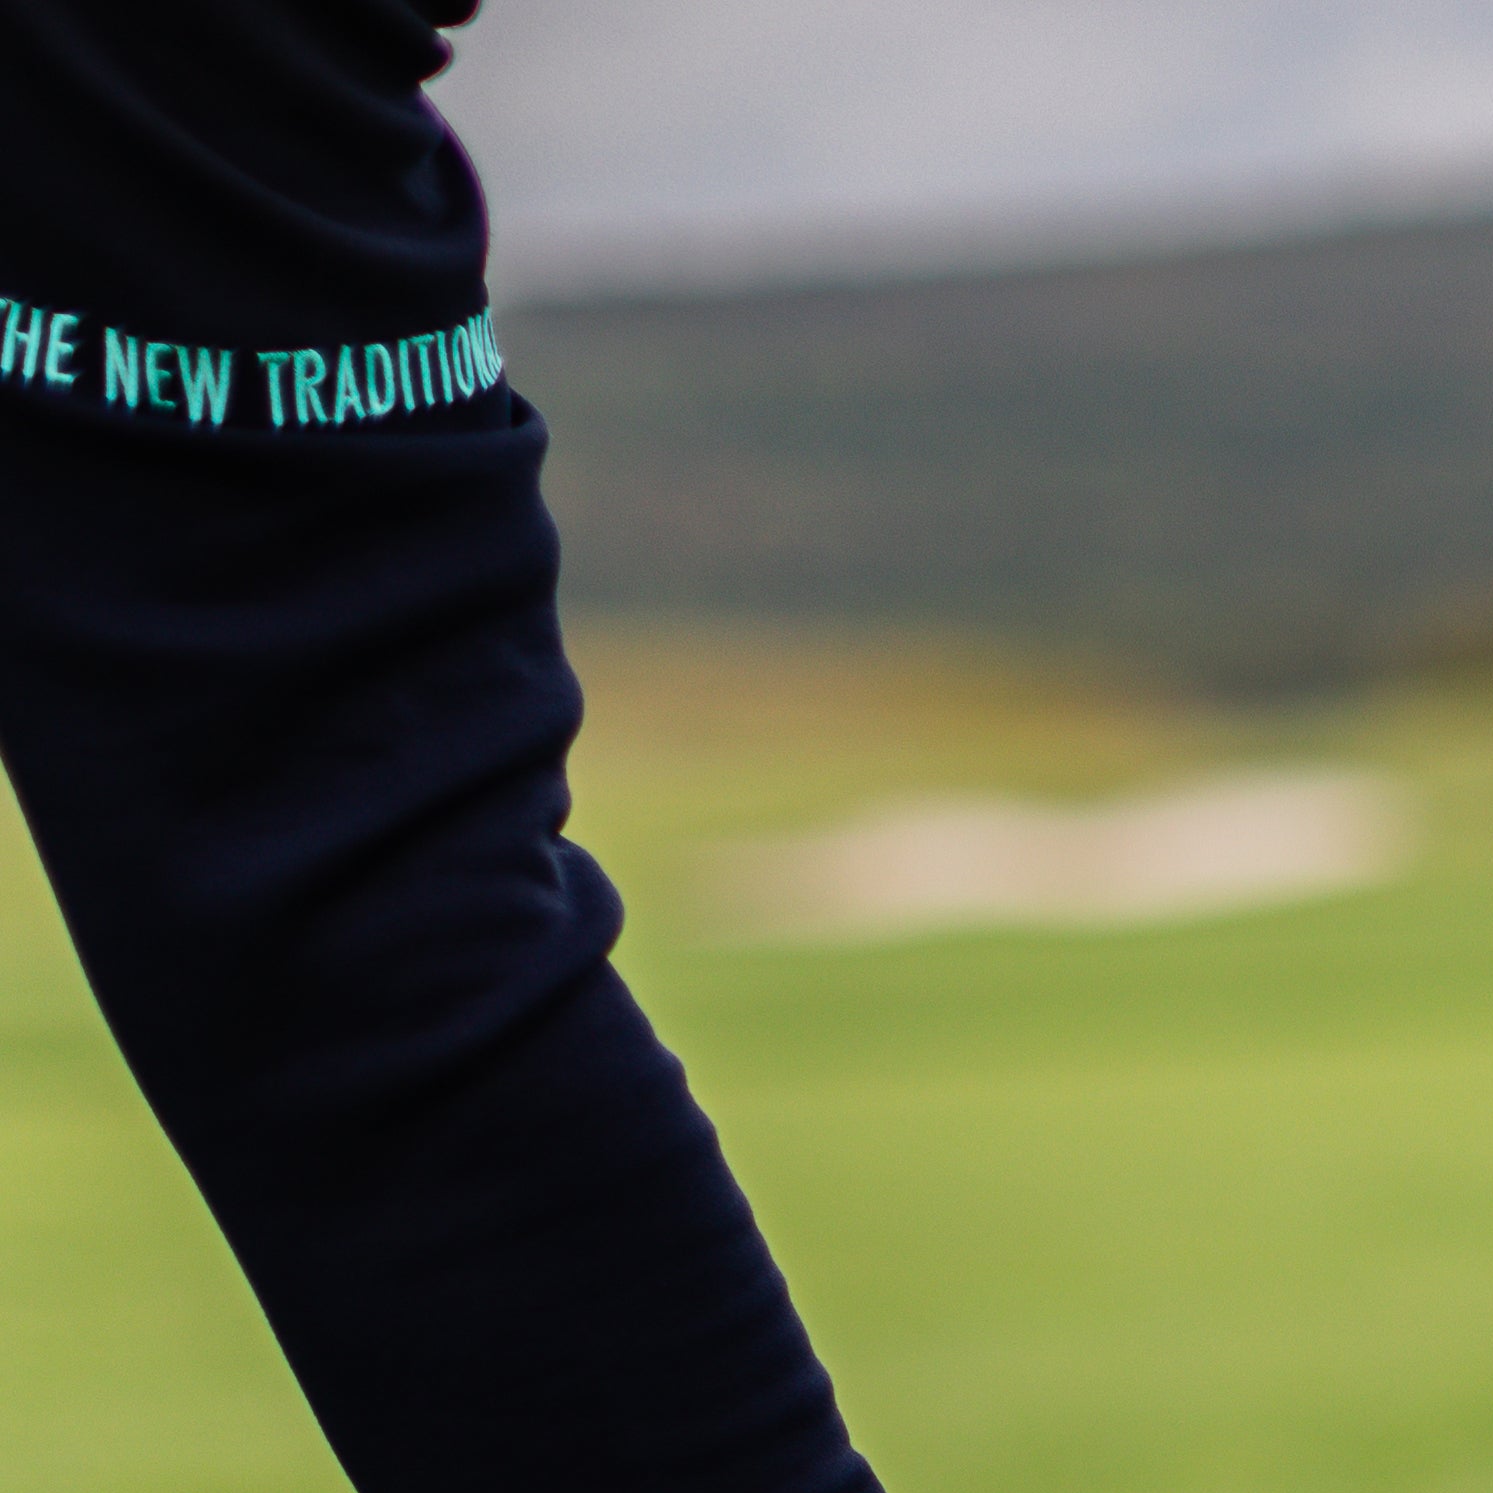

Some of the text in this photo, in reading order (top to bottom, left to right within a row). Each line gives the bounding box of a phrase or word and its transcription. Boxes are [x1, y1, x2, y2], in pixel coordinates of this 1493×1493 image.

[0, 297, 503, 428] HE NEW TRADITIONA
